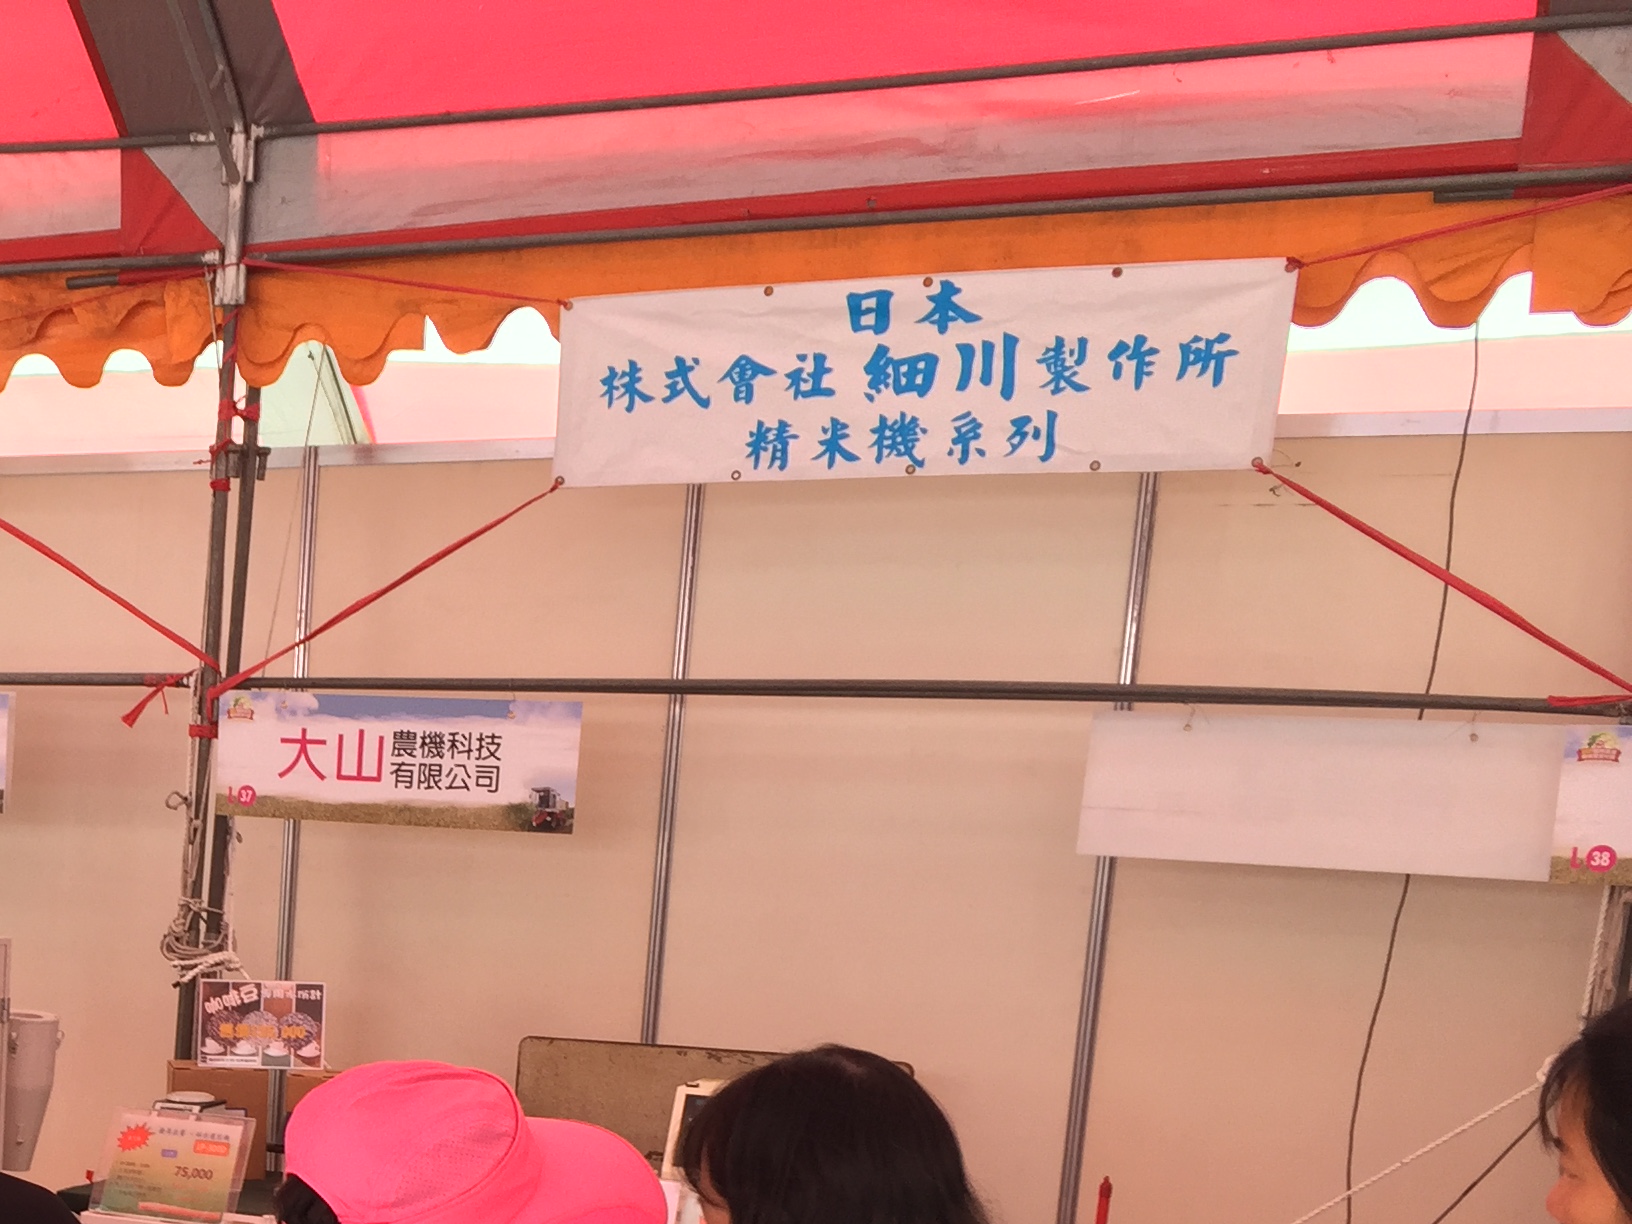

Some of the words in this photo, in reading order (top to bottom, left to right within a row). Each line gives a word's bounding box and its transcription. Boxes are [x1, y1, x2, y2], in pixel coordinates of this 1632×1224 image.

[846, 281, 982, 335] 日本
[598, 332, 1241, 413] 株式會社細川製作所
[744, 410, 1060, 472] 精米機系列
[277, 727, 385, 782] 大山
[390, 729, 503, 761] 農機科技
[389, 761, 501, 794] 有限公司
[240, 789, 252, 802] 37
[1590, 850, 1611, 867] 38
[174, 1165, 213, 1180] 75,000
